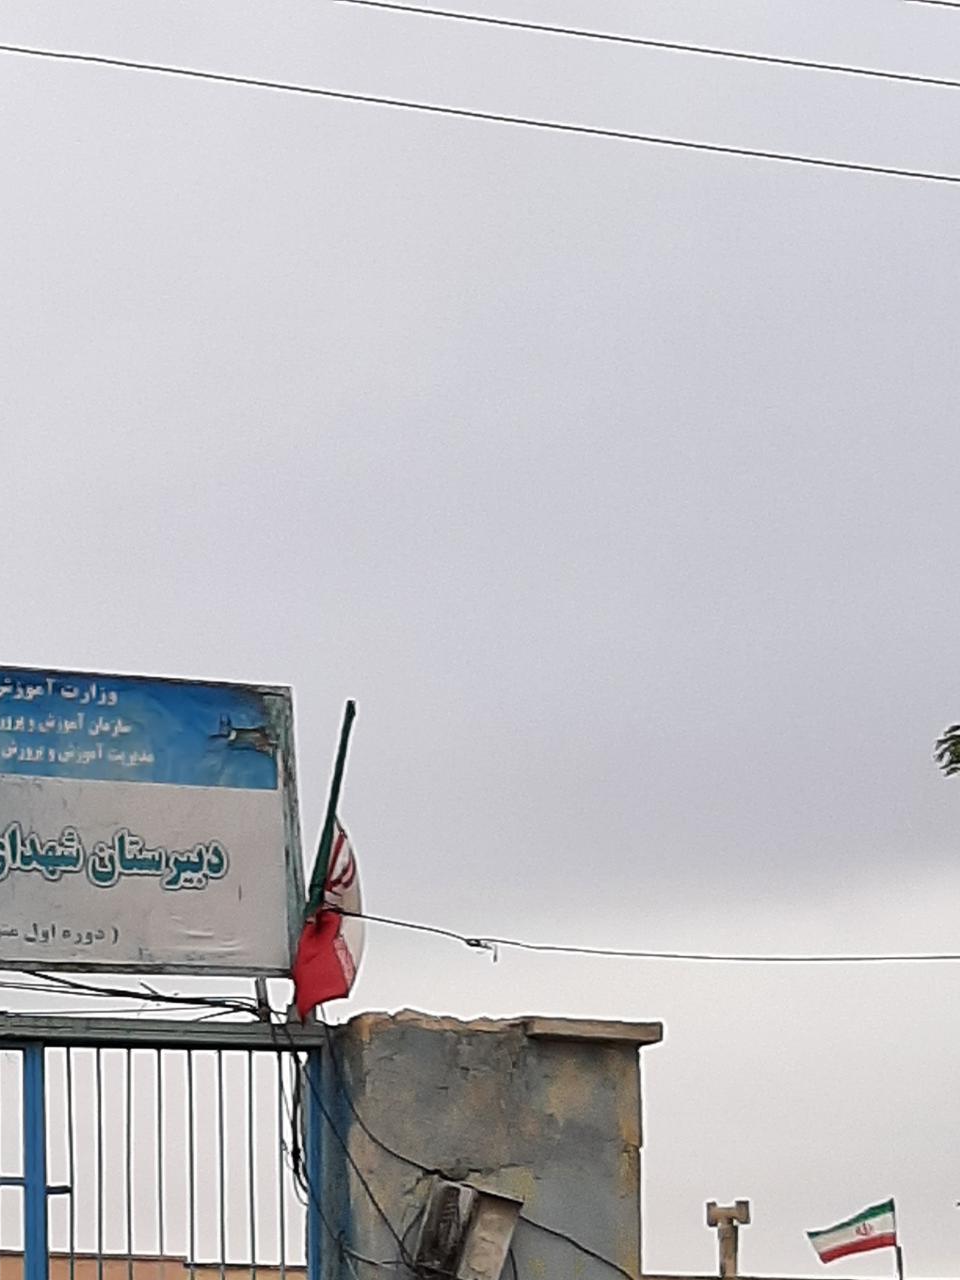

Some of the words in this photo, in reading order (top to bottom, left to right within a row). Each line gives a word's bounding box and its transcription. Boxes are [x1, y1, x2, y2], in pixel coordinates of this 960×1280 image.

[61, 682, 118, 706] وزارت
[38, 712, 84, 734] آموزش
[87, 827, 229, 890] دبیرستان
[24, 922, 56, 943] اول
[62, 928, 105, 945] دوره
